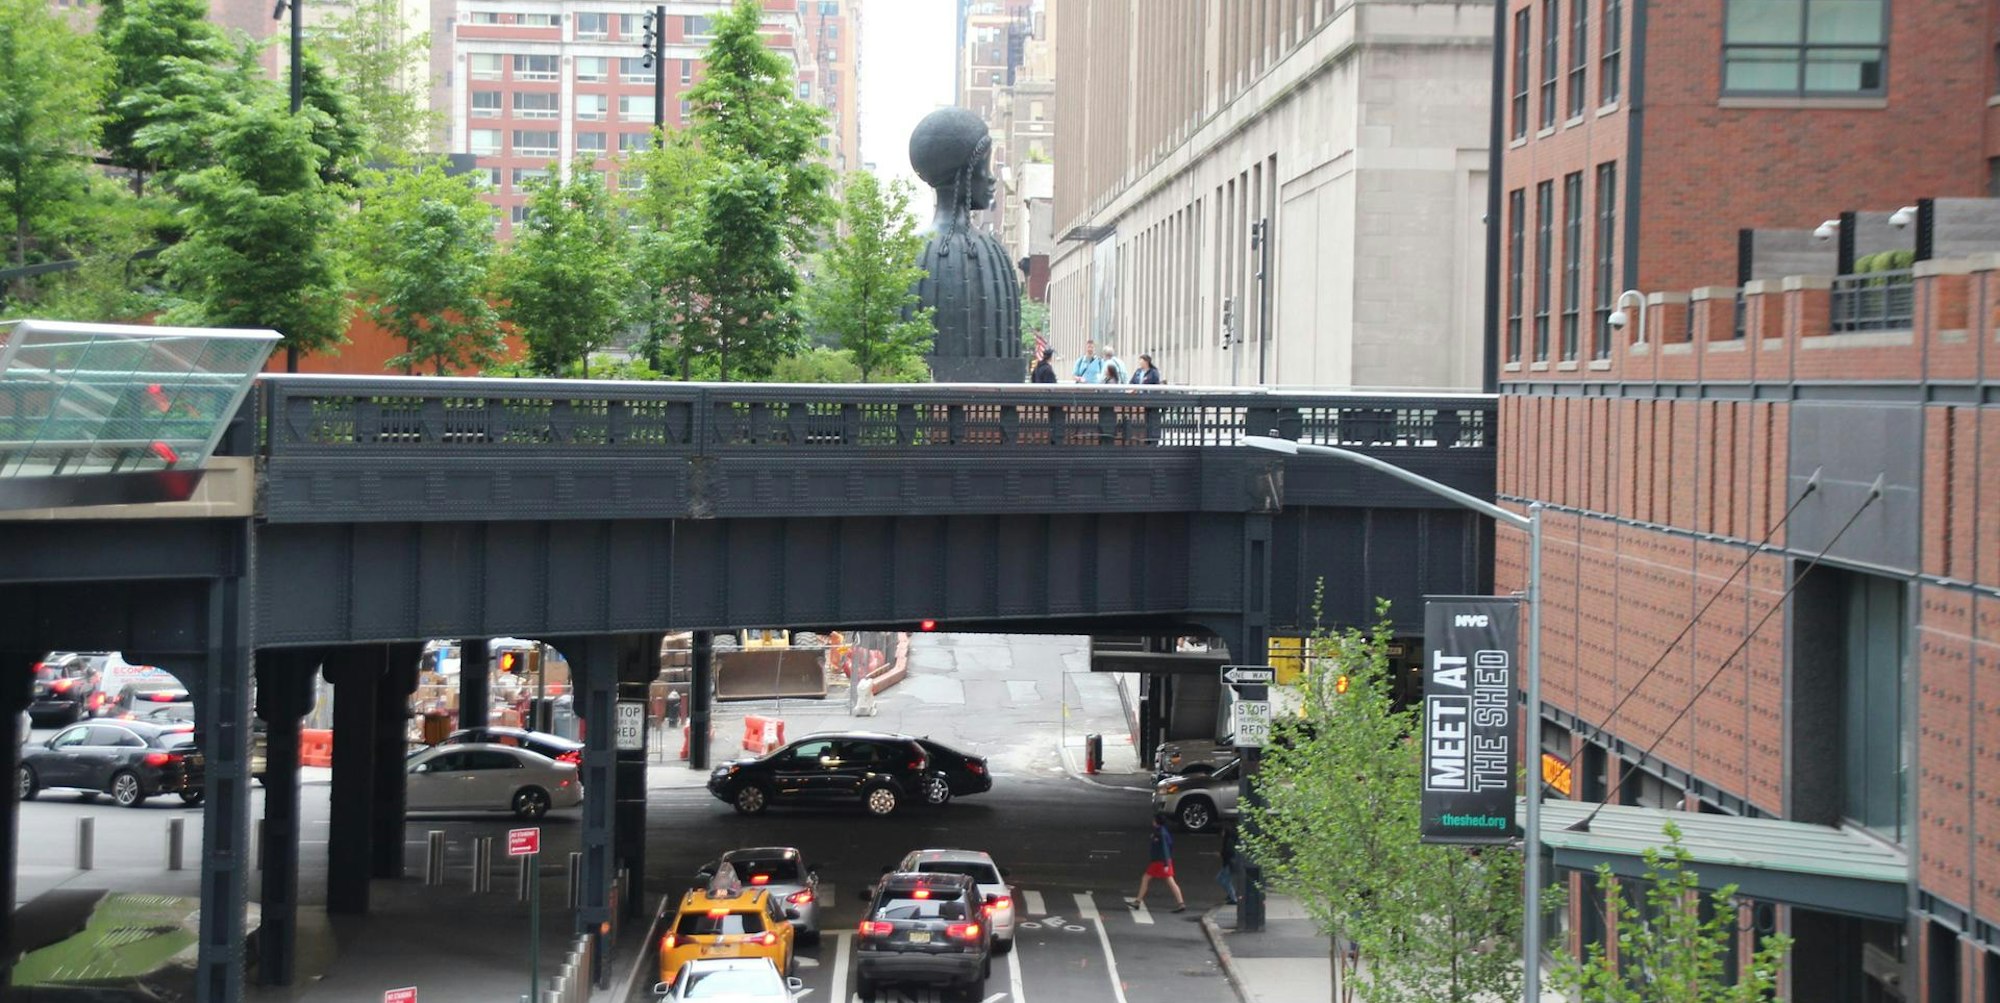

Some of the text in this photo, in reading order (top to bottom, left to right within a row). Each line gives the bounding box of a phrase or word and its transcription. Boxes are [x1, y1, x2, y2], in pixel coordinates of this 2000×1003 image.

[1455, 614, 1488, 627] NYC
[1229, 671, 1269, 680] ONE WAY
[618, 706, 640, 717] TOP
[1431, 650, 1467, 787] MEET AT
[1473, 650, 1508, 793] THE SHED
[1241, 725, 1263, 735] RED
[1443, 814, 1506, 829] theshed.org
